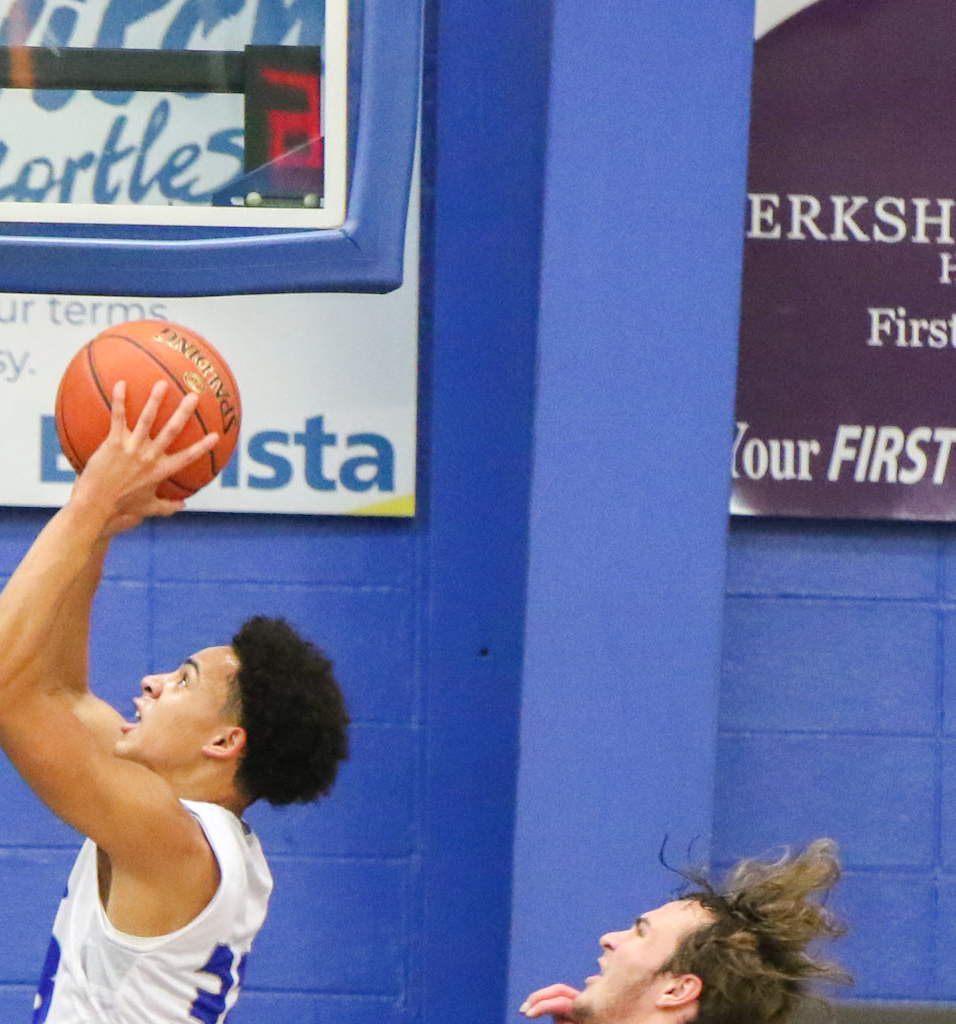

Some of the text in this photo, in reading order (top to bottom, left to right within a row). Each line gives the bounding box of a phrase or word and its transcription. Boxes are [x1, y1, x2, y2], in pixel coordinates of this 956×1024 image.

[747, 192, 956, 245] ERKSH
[49, 297, 168, 325] terms
[153, 327, 239, 434] SPALDING
[827, 424, 956, 485] FIRST
